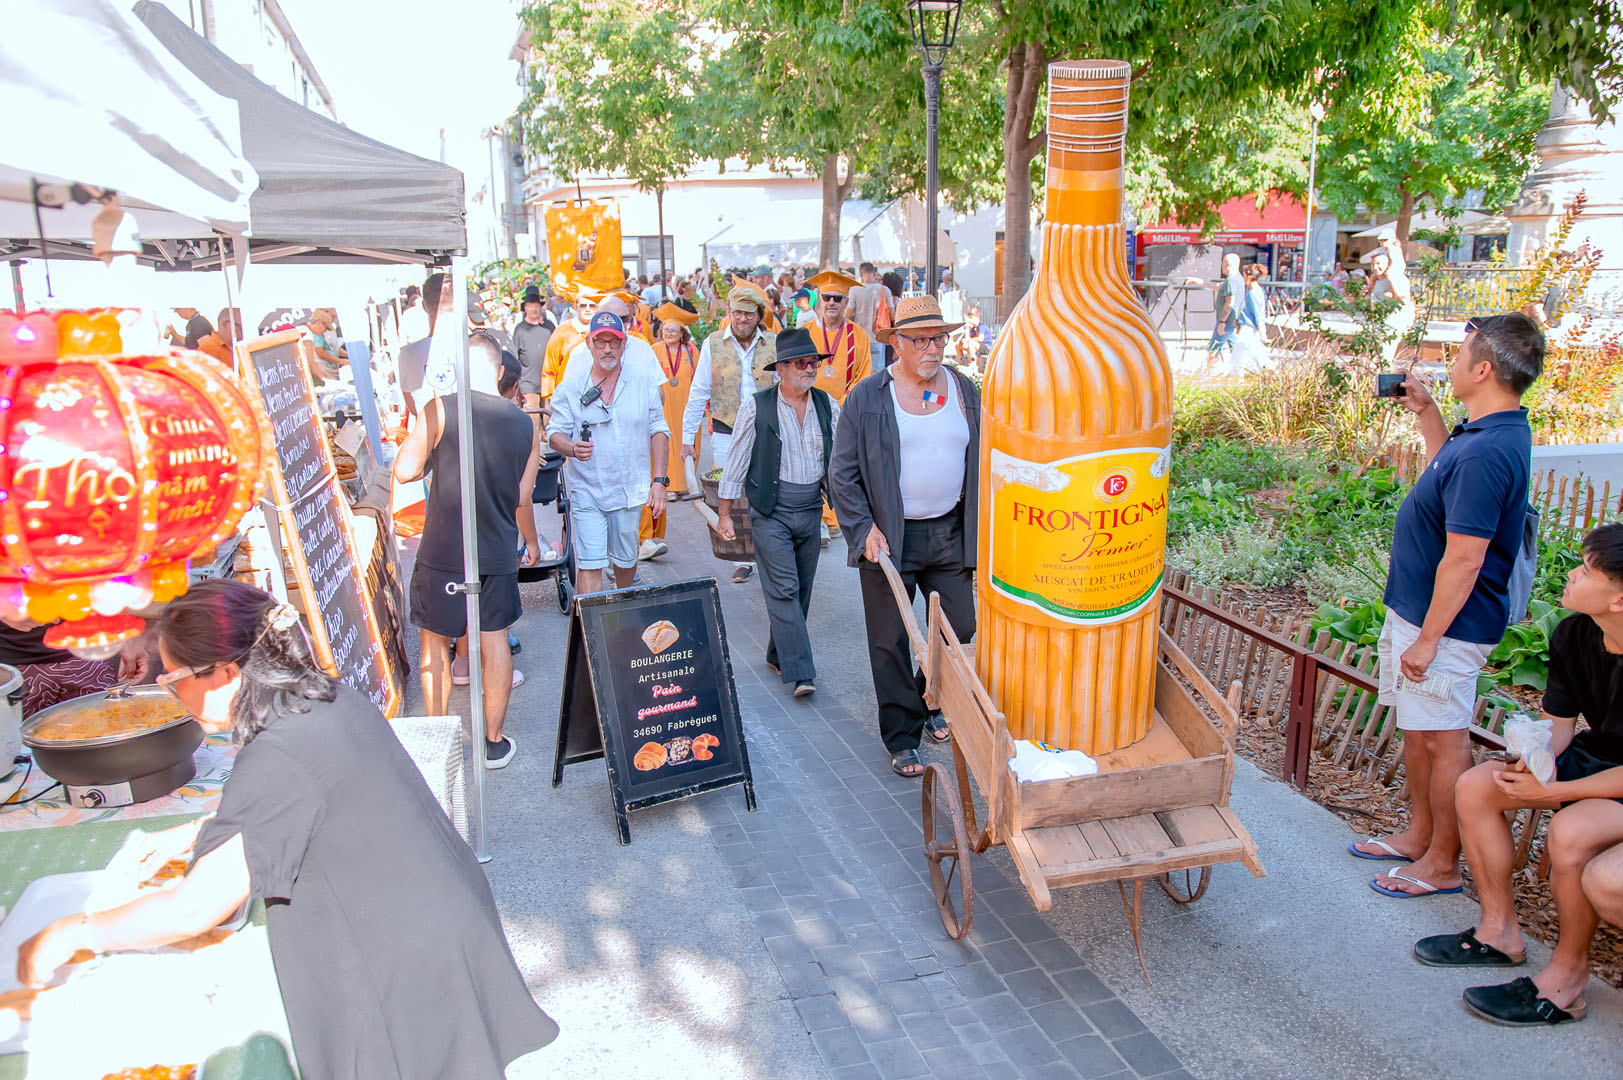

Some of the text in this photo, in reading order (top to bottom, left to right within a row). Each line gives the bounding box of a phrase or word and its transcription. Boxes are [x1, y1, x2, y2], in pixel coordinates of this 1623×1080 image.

[1013, 487, 1169, 533] FRONTIGNA
[1033, 558, 1162, 587] MUSCAT DE TRADITION
[630, 649, 694, 669] BOULANGERIE
[638, 665, 695, 684] Artisanale
[651, 683, 682, 699] Pain
[637, 695, 698, 721] gourmand
[633, 713, 718, 739] 34690 Fabrègues
